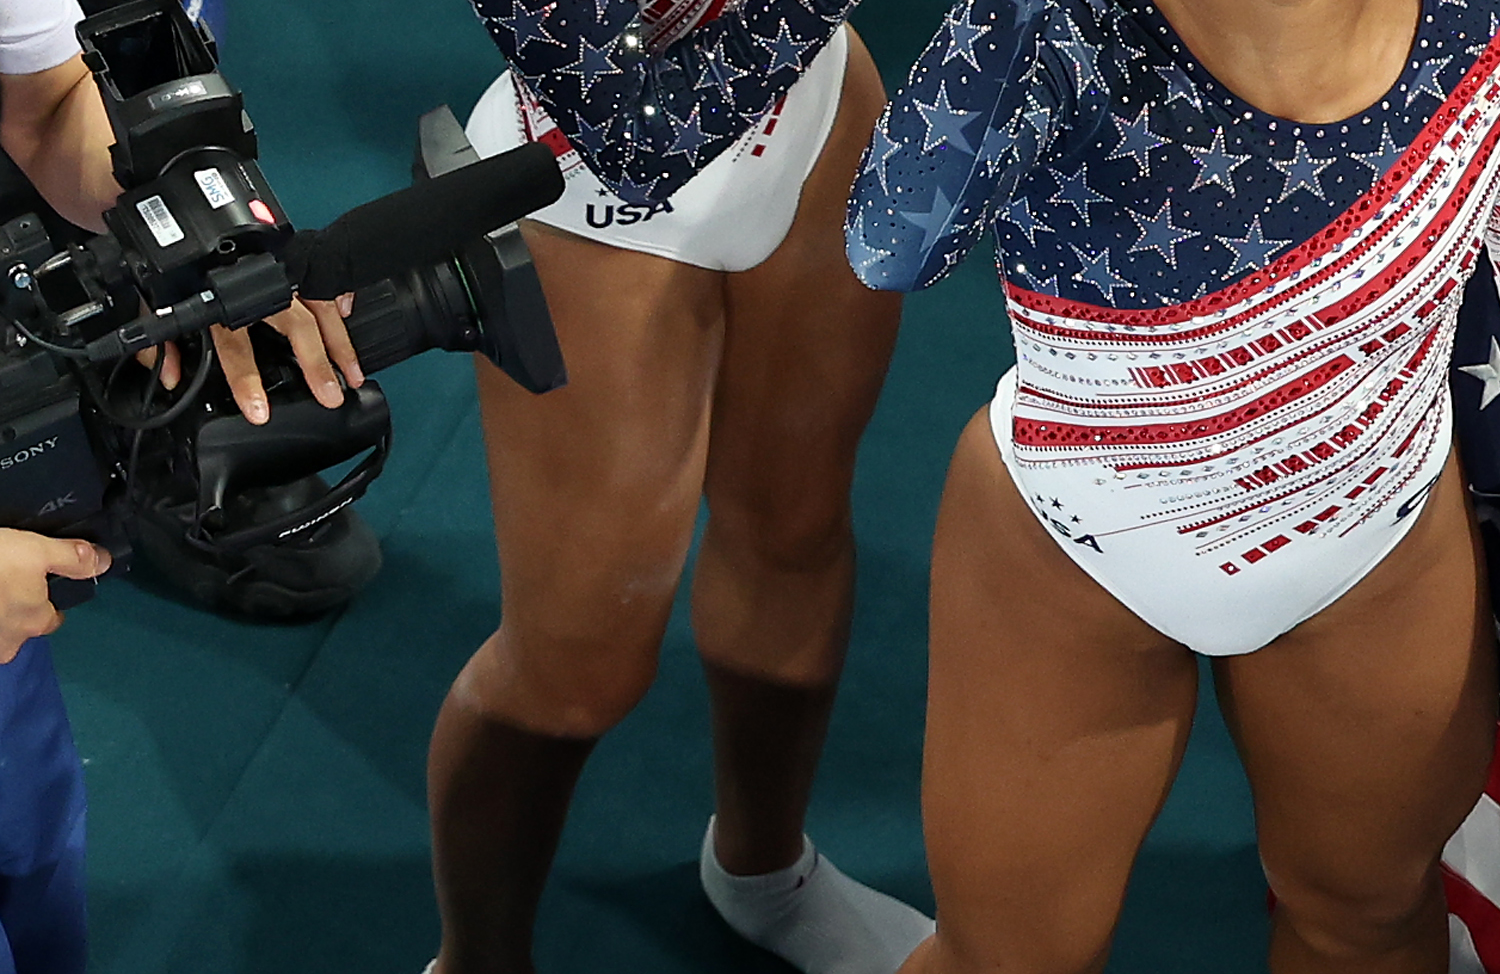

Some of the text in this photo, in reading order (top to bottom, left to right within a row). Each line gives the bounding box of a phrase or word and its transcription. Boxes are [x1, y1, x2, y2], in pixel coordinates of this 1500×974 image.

[201, 175, 225, 203] SMG
[586, 197, 675, 229] USA
[0, 436, 59, 469] SONY
[38, 491, 77, 516] 4K
